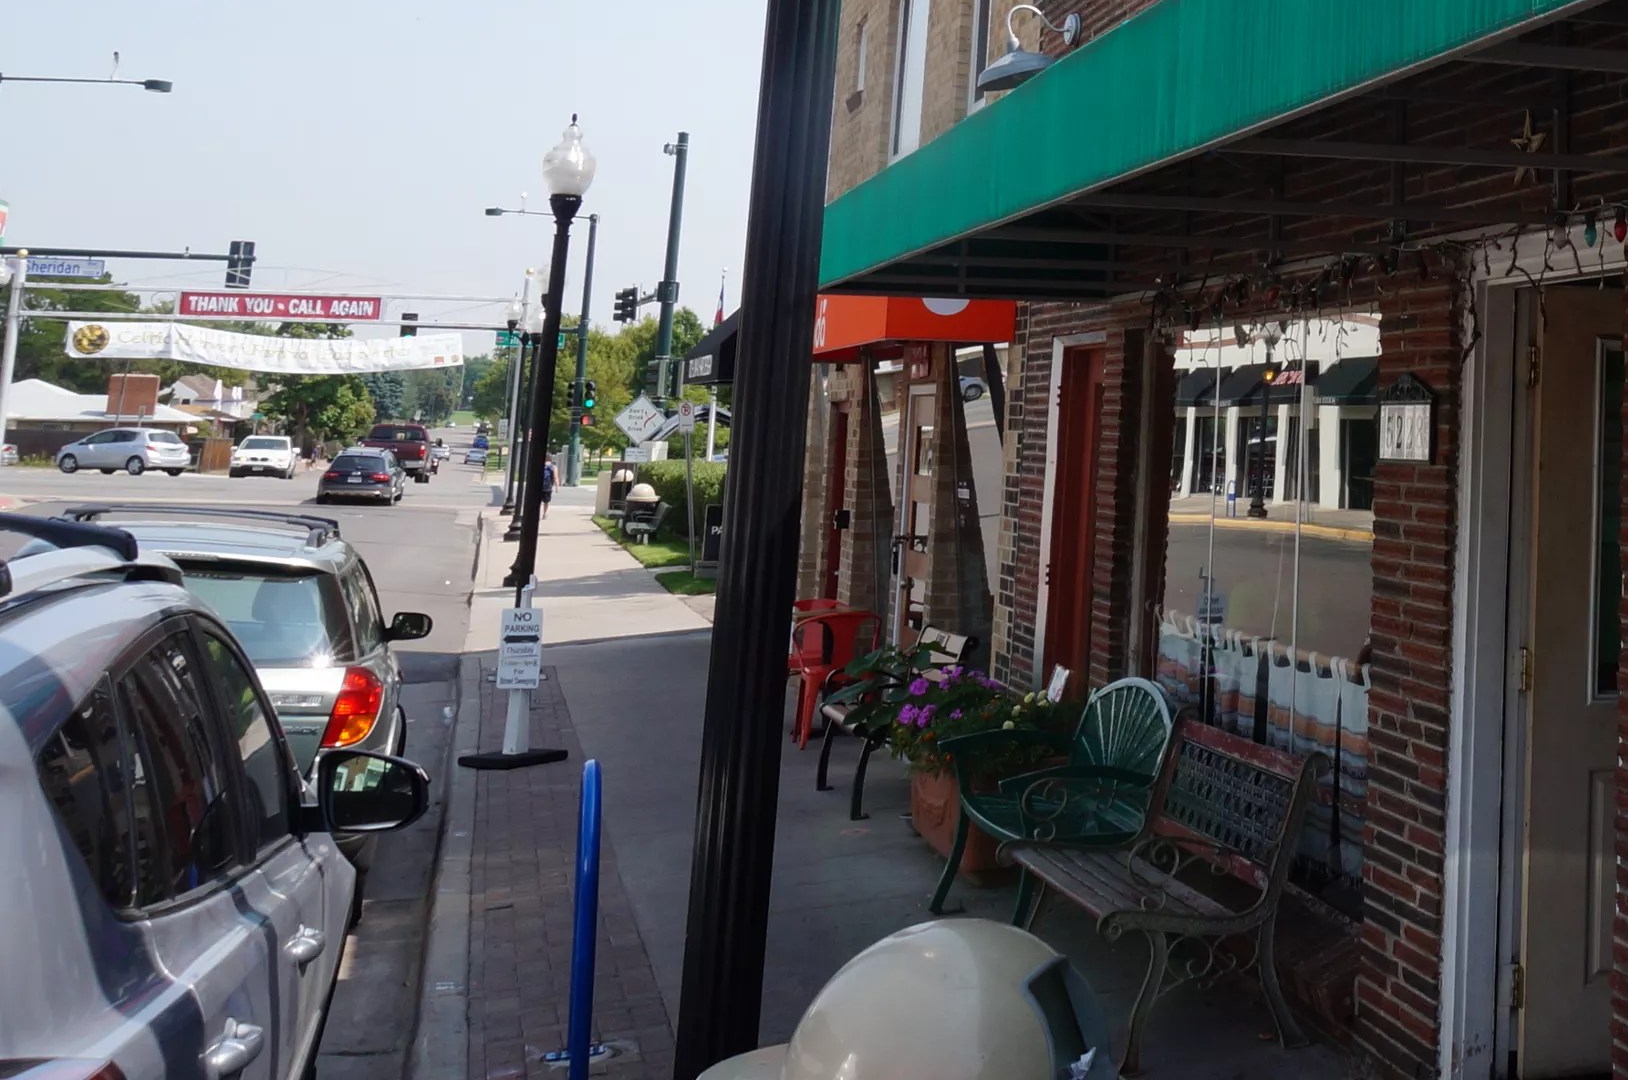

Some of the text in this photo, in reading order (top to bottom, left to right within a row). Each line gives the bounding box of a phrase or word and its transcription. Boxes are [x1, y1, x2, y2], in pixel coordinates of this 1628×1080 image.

[189, 296, 239, 313] THANK
[245, 297, 274, 313] YOU
[288, 299, 324, 315] CALL
[329, 300, 374, 316] AGAIN
[514, 612, 532, 622] NO
[505, 624, 540, 633] PARKING
